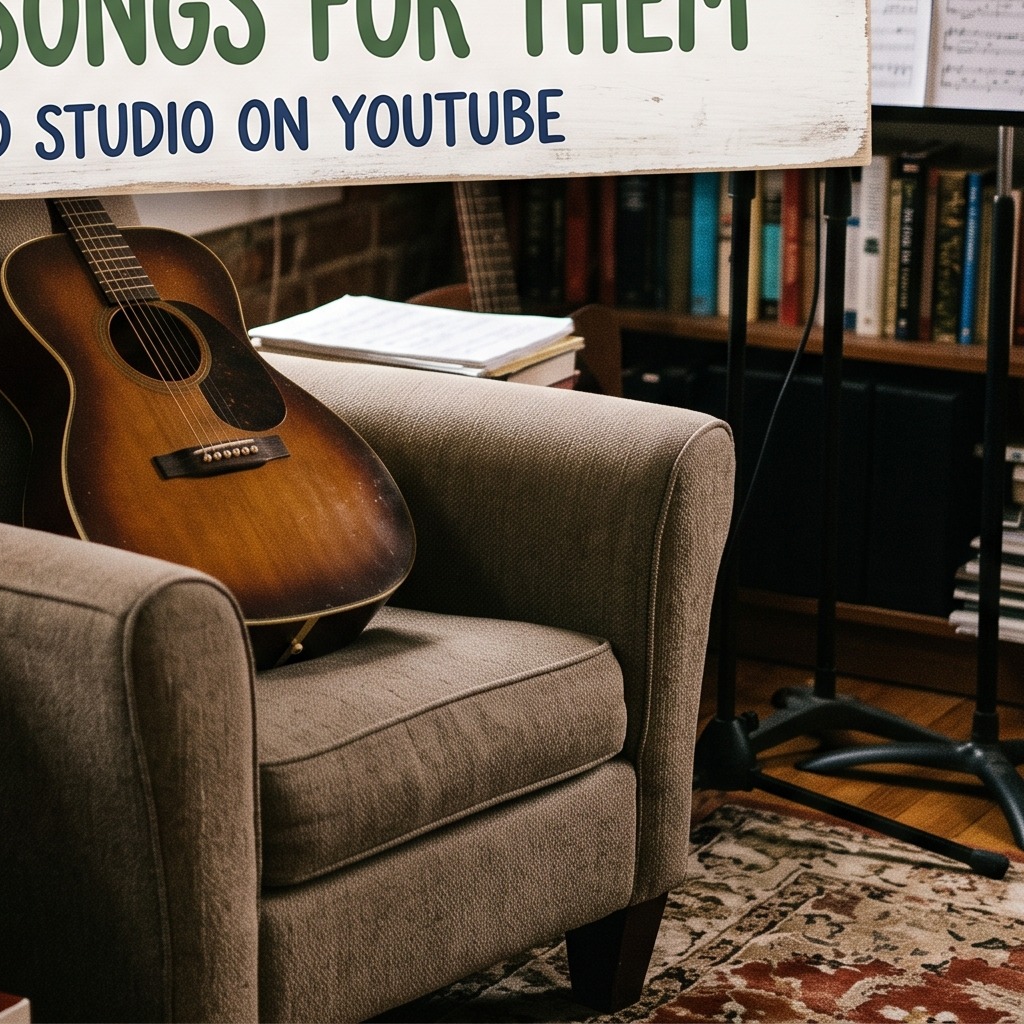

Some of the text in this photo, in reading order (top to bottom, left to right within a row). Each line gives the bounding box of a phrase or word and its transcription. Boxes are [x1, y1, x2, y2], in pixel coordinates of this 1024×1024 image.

[35, 97, 213, 161] STUDIO
[237, 96, 308, 153] ON
[331, 89, 565, 151] YOUTUBE
